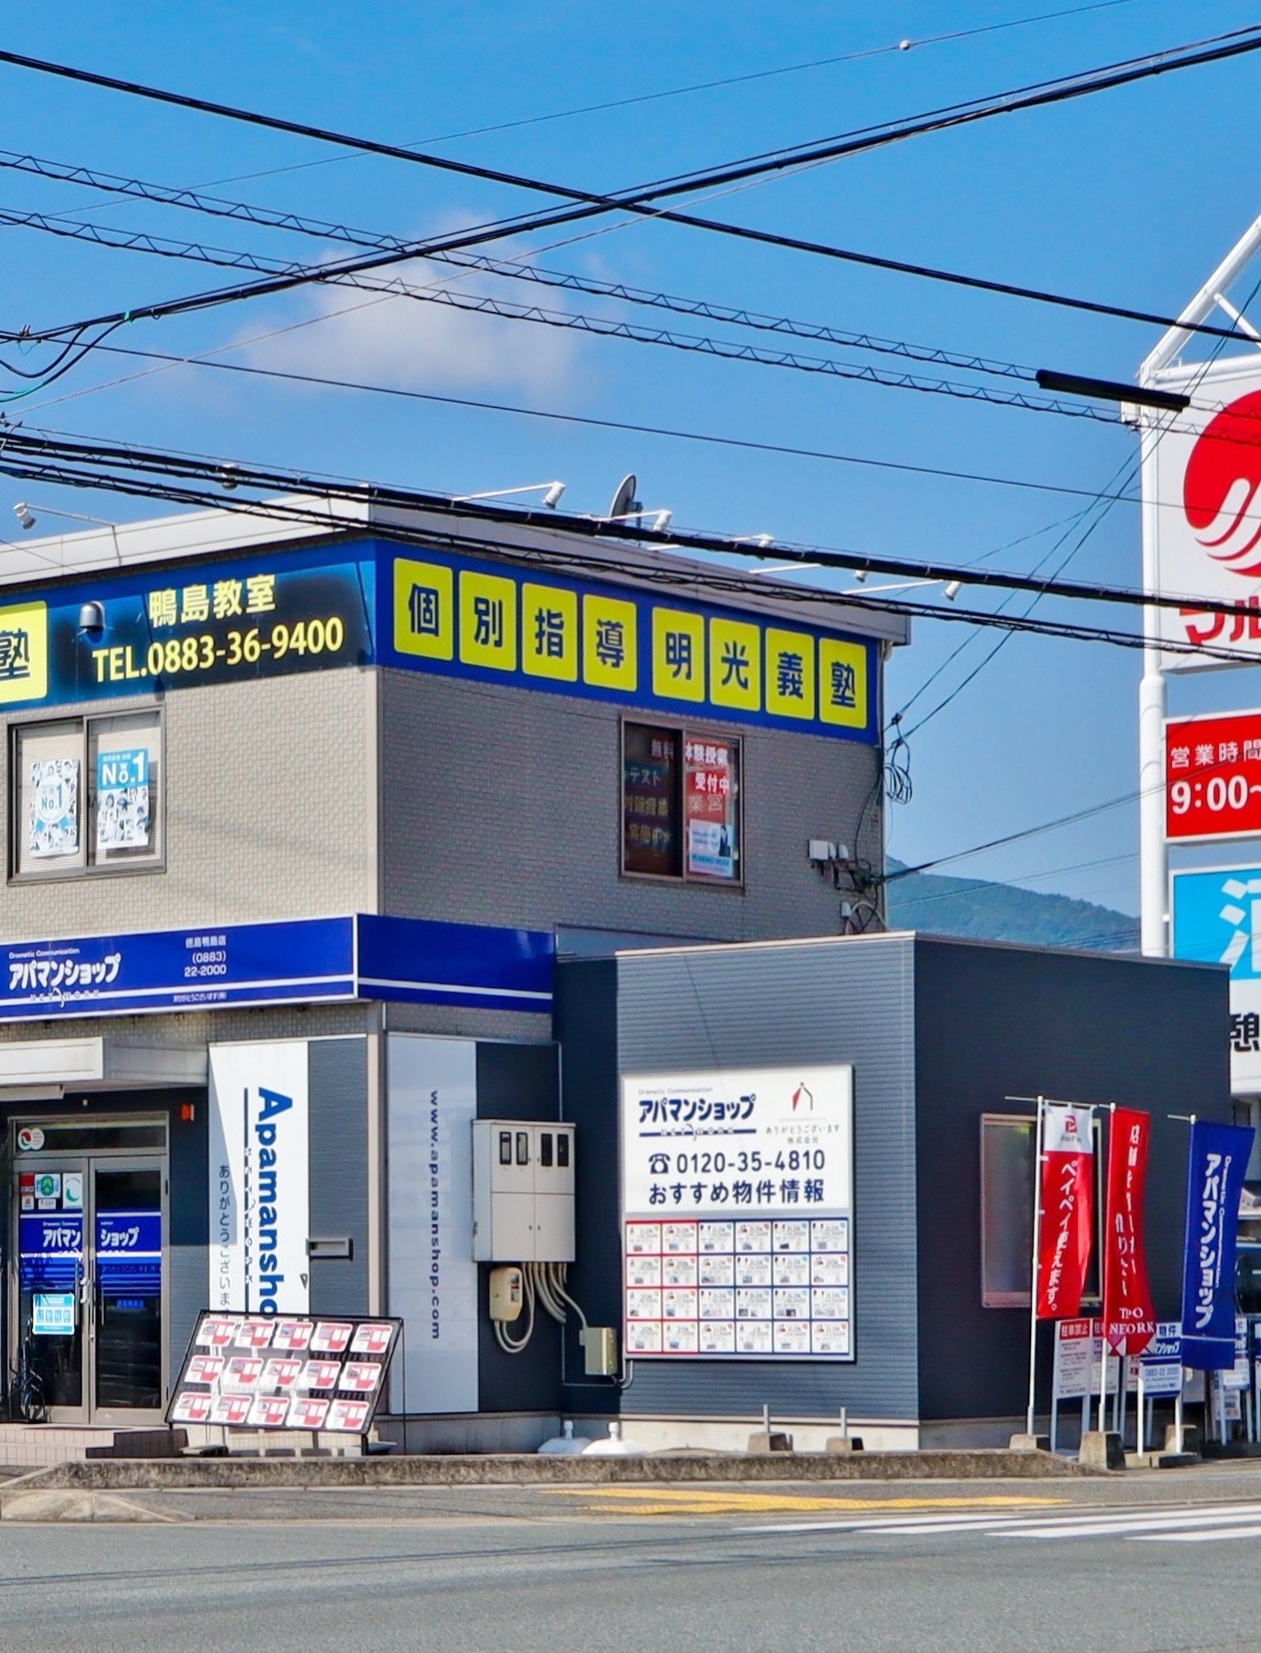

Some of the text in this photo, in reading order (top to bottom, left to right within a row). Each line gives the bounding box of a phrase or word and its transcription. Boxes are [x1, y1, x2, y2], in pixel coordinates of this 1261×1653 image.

[149, 574, 276, 628] 鴨島教室
[92, 617, 344, 683] TEL.0883-36-9400
[408, 583, 856, 710] 個別指導 明光義塾
[9, 952, 122, 991] アパマンショップ
[184, 963, 227, 978] 22-2000
[192, 950, 227, 965] (0883)
[638, 1093, 757, 1123] アパマンショップ
[676, 1150, 826, 1174] 0120-35-4810
[649, 1178, 825, 1205] おすすめ物件情報
[429, 1090, 441, 1340] www.apamanshop.com
[43, 1226, 140, 1248] アパマン ショップ
[219, 1164, 231, 1311] ありがとうございま
[1196, 1153, 1222, 1329] アパマンショップ
